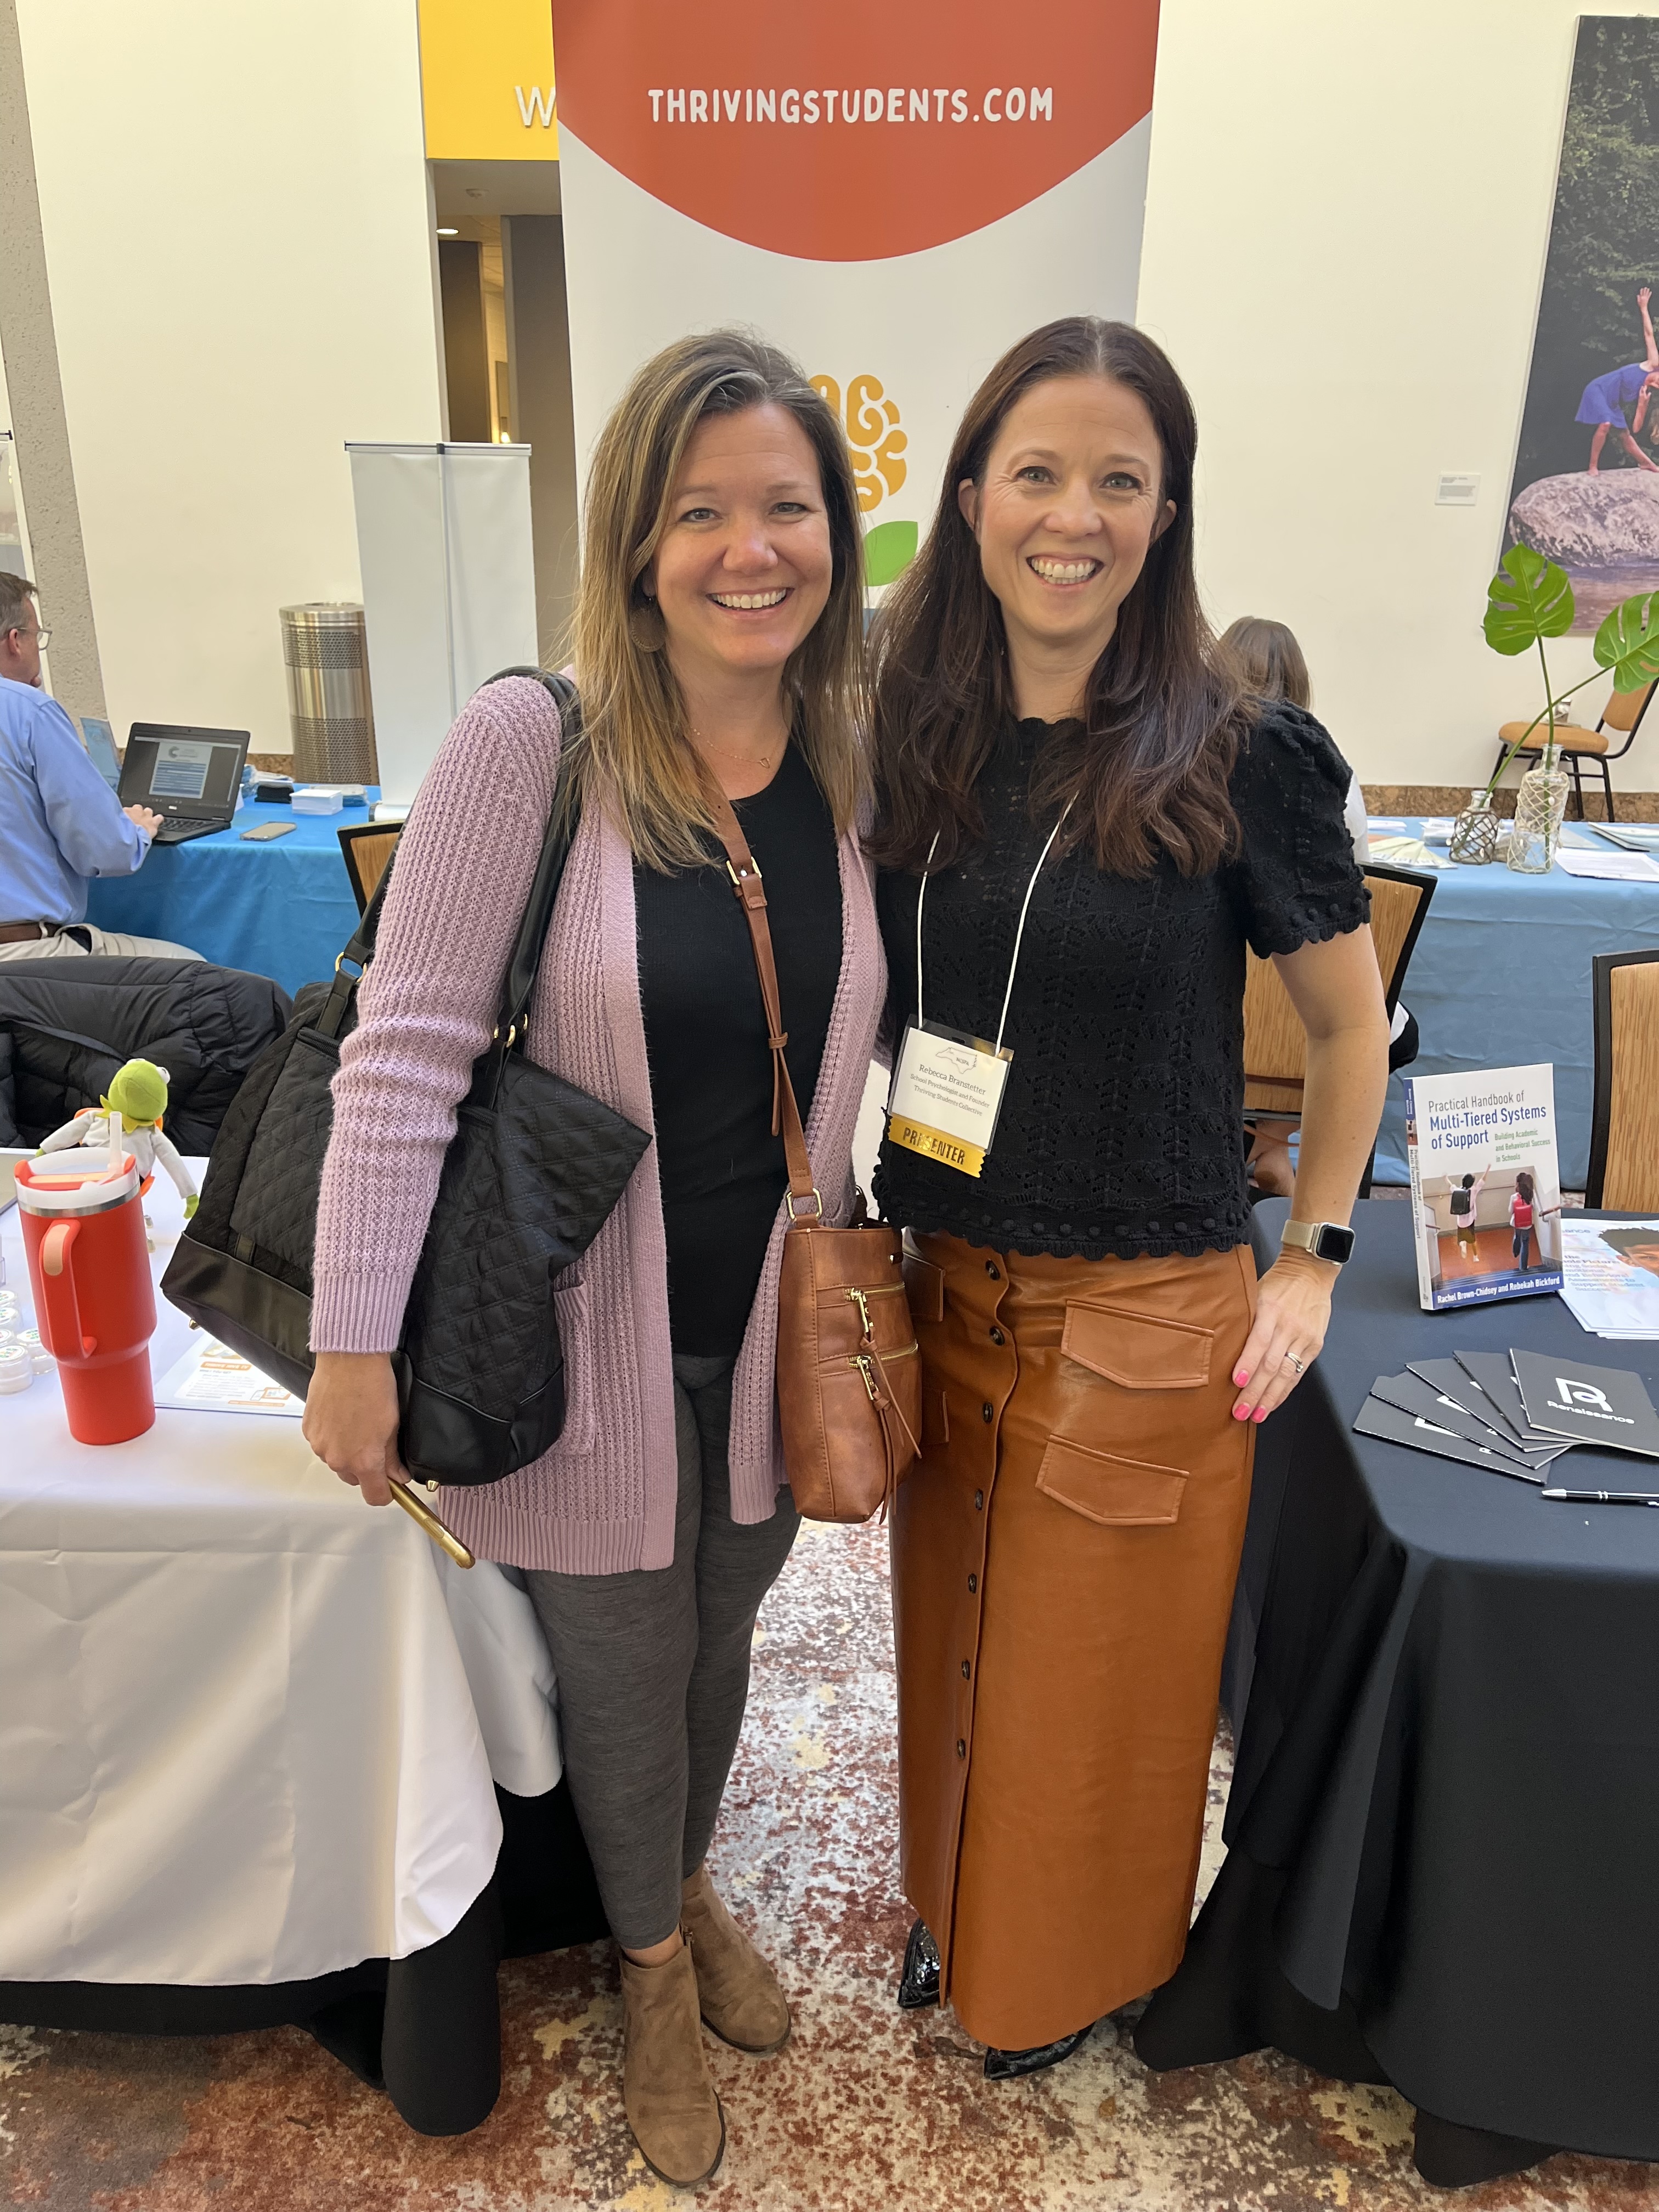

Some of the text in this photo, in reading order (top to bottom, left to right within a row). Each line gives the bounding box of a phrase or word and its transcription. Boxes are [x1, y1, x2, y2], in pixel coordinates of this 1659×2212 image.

[648, 87, 1054, 123] THRIVINGSTUDENTS.COM
[910, 1074, 990, 1108] School Psychologist and Founder
[919, 1064, 986, 1095] Rebecca Branstetter
[914, 1085, 983, 1116] Thriving Students Collective
[1429, 1090, 1524, 1113] Practical Handbook of
[1430, 1106, 1546, 1131] Multi-Tiered Systems
[1431, 1130, 1489, 1150] of Support
[1494, 1128, 1538, 1141] Building Academic
[1505, 1141, 1530, 1150] Behavioral
[1531, 1138, 1550, 1147] Success
[1502, 1153, 1520, 1162] Schools
[1437, 1276, 1560, 1304] Rachel Brown-Chidsey and Rebekah Bickford
[1547, 1400, 1635, 1424] Renaissance
